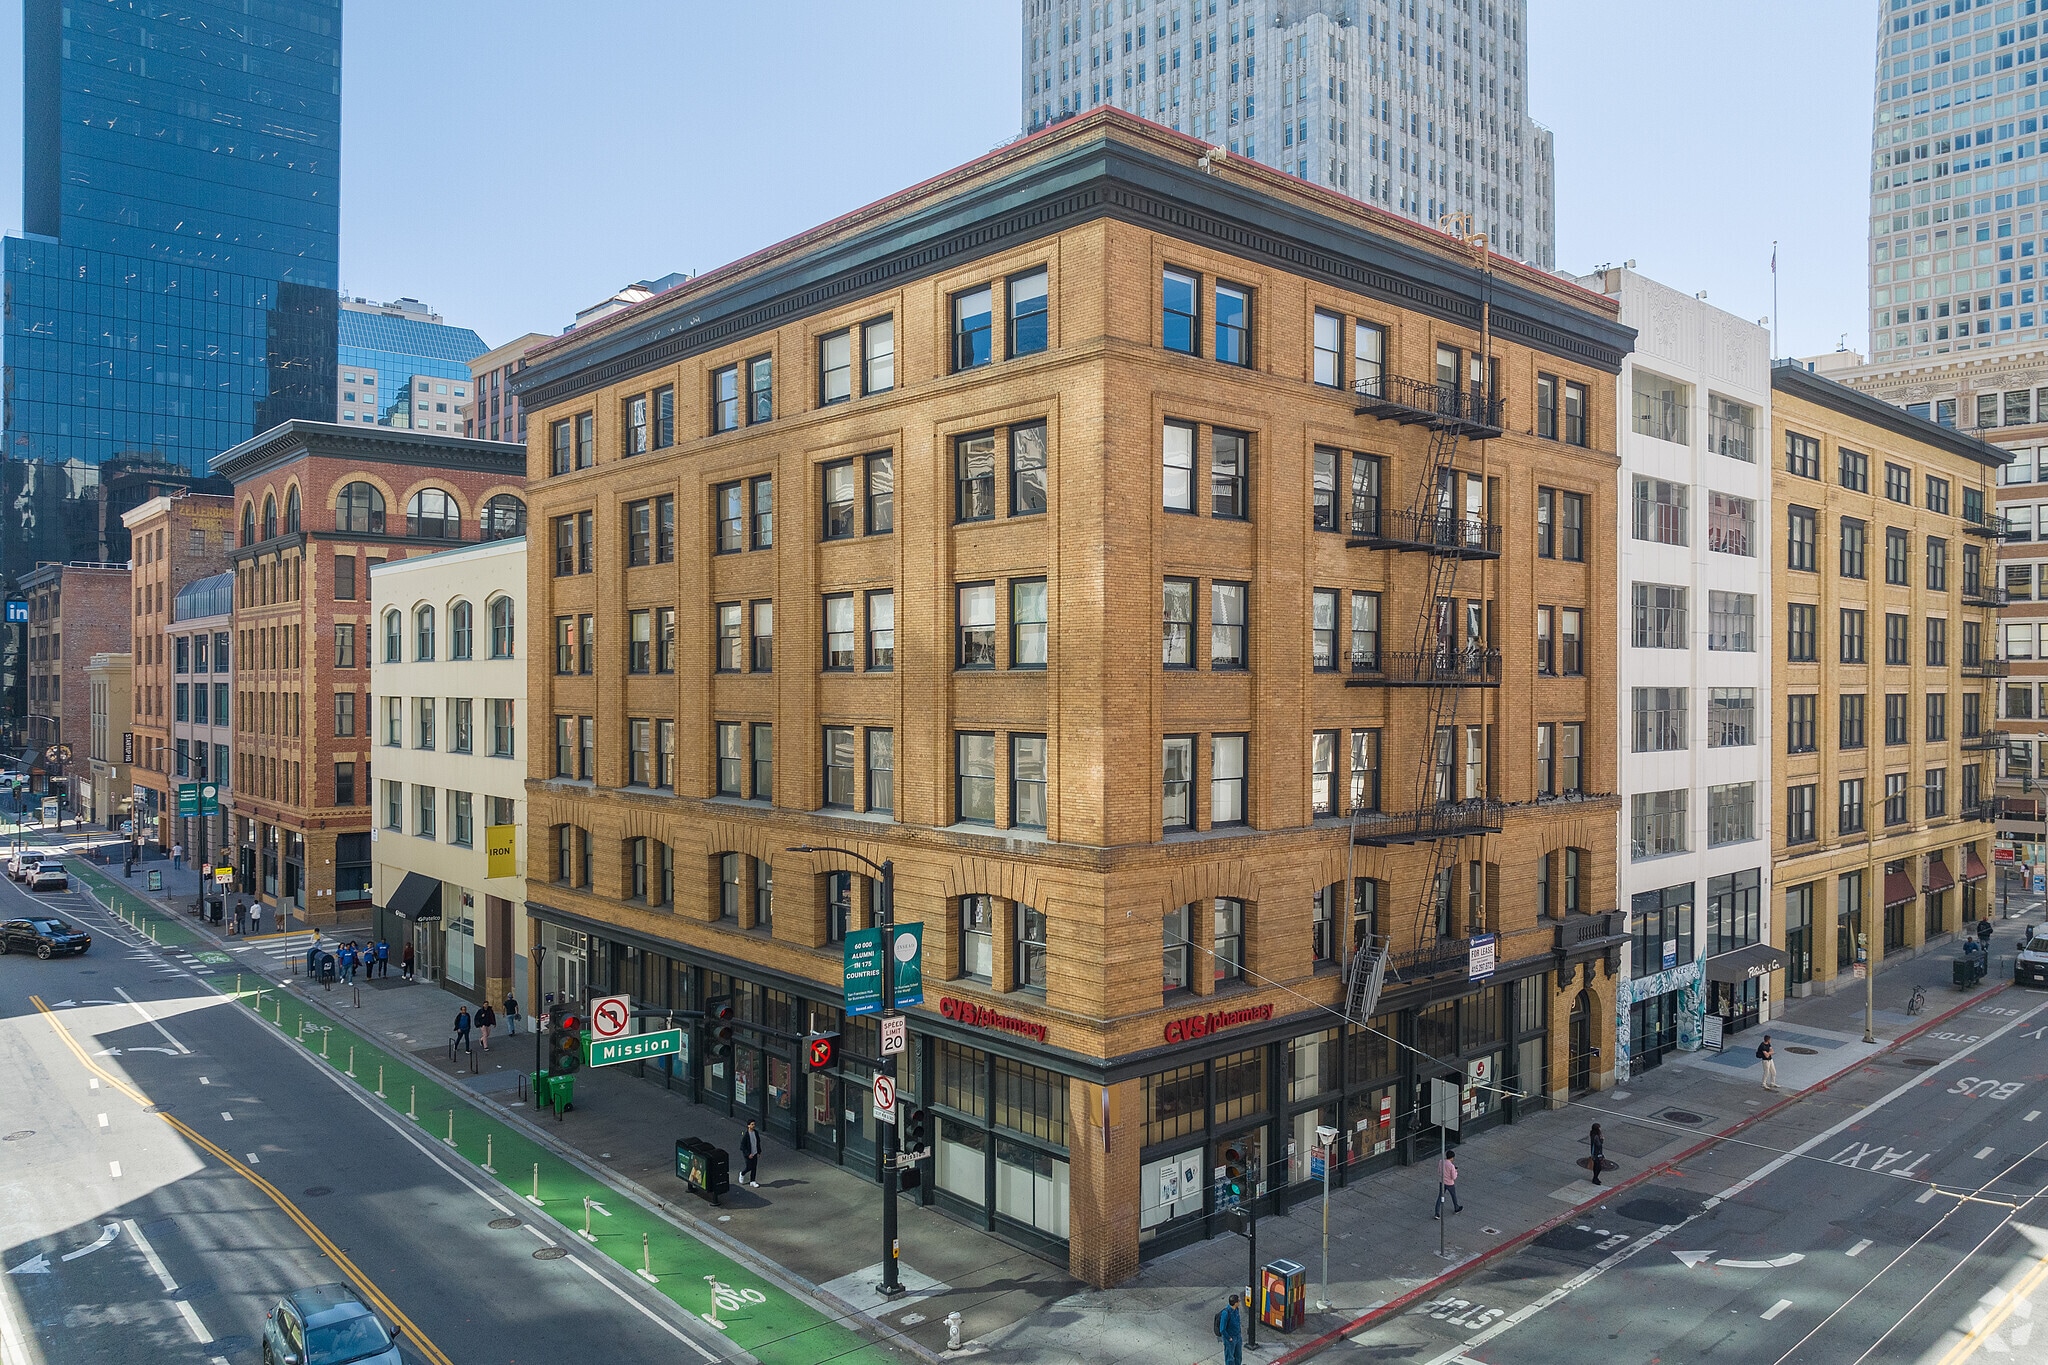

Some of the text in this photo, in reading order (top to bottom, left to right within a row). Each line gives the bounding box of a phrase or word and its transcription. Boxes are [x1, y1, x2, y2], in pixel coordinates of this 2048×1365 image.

[9, 604, 28, 620] in
[489, 847, 510, 856] IRON
[852, 950, 875, 960] ALUMNI
[1471, 945, 1493, 958] FOR LEASE
[846, 969, 880, 979] COUNTRIES
[1977, 1006, 2020, 1017] BUS
[884, 1020, 904, 1030] SPEED
[940, 996, 1047, 1042] CVS/pharmacy
[1164, 1003, 1274, 1044] CVS/pharmacy
[885, 1027, 902, 1037] LIMIT
[1926, 1031, 1980, 1044] STOP
[603, 1039, 669, 1060] Mission
[885, 1035, 903, 1051] 20
[1946, 1076, 2025, 1100] BUS
[1828, 1141, 1931, 1177] TAXI
